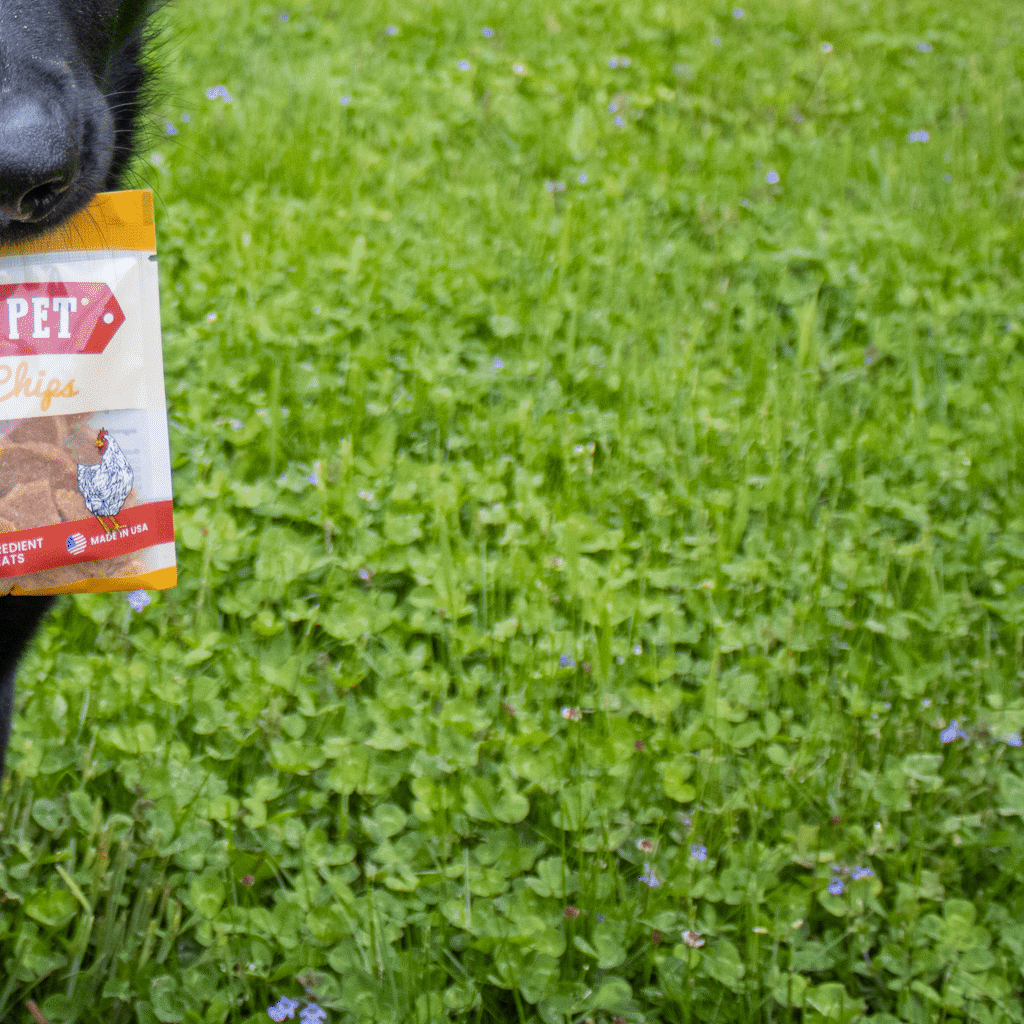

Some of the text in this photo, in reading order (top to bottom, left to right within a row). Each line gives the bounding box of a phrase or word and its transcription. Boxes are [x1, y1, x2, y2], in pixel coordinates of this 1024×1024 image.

[6, 296, 77, 340] PET
[90, 523, 149, 546] MADE IN USA
